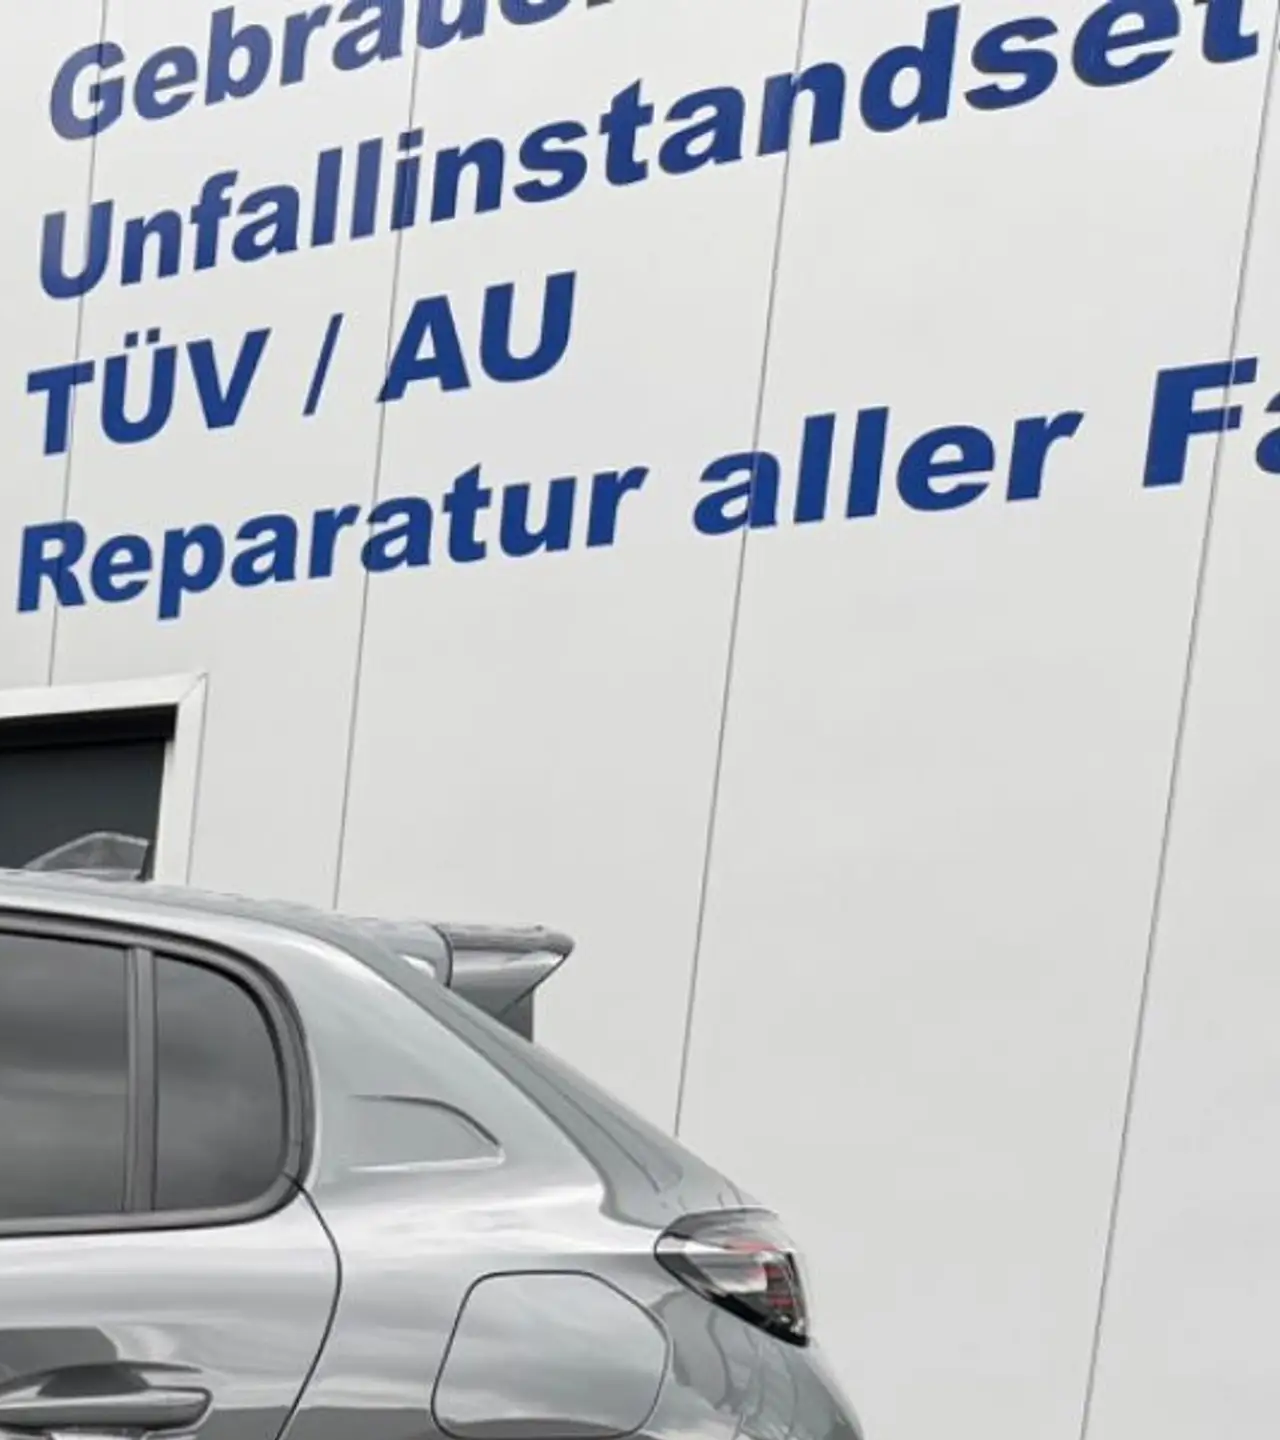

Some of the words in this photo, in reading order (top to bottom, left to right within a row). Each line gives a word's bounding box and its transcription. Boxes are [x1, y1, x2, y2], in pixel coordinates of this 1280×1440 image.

[25, 330, 271, 457] TÜV
[304, 314, 344, 415] /
[376, 271, 578, 403] AU
[16, 463, 649, 621] Reparatur
[691, 406, 1084, 536] aller
